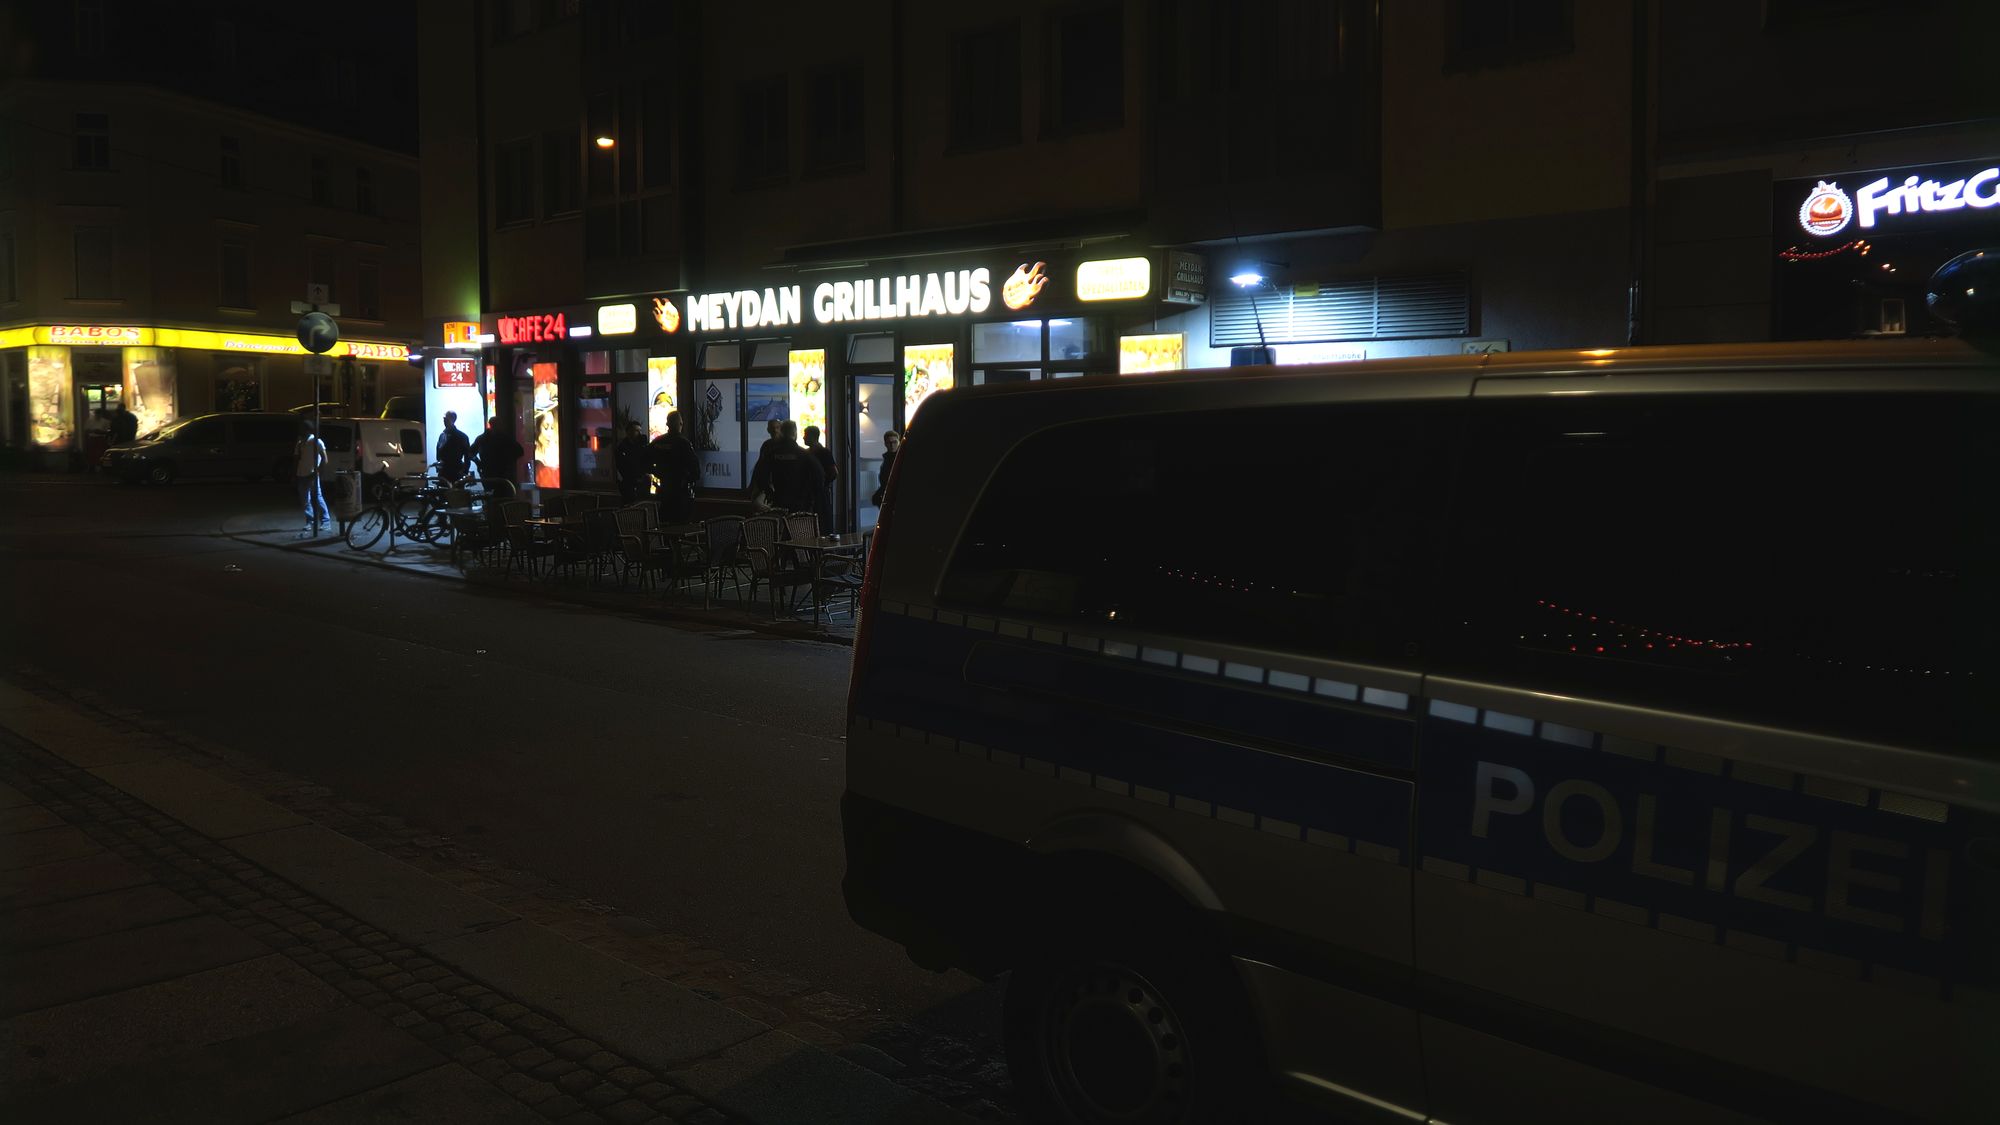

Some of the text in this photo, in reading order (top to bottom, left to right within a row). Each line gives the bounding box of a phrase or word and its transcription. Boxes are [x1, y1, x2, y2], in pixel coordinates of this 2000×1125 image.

[1179, 261, 1202, 273] MEYDAN
[1176, 271, 1204, 284] GRILLHAUS
[686, 267, 991, 332] MEYDAN GRILLHAUS
[51, 326, 140, 337] BABOS
[512, 312, 566, 343] CAFE 24
[451, 362, 470, 373] CAFE
[451, 373, 463, 382] 24
[1471, 760, 1953, 943] POLIZEI
